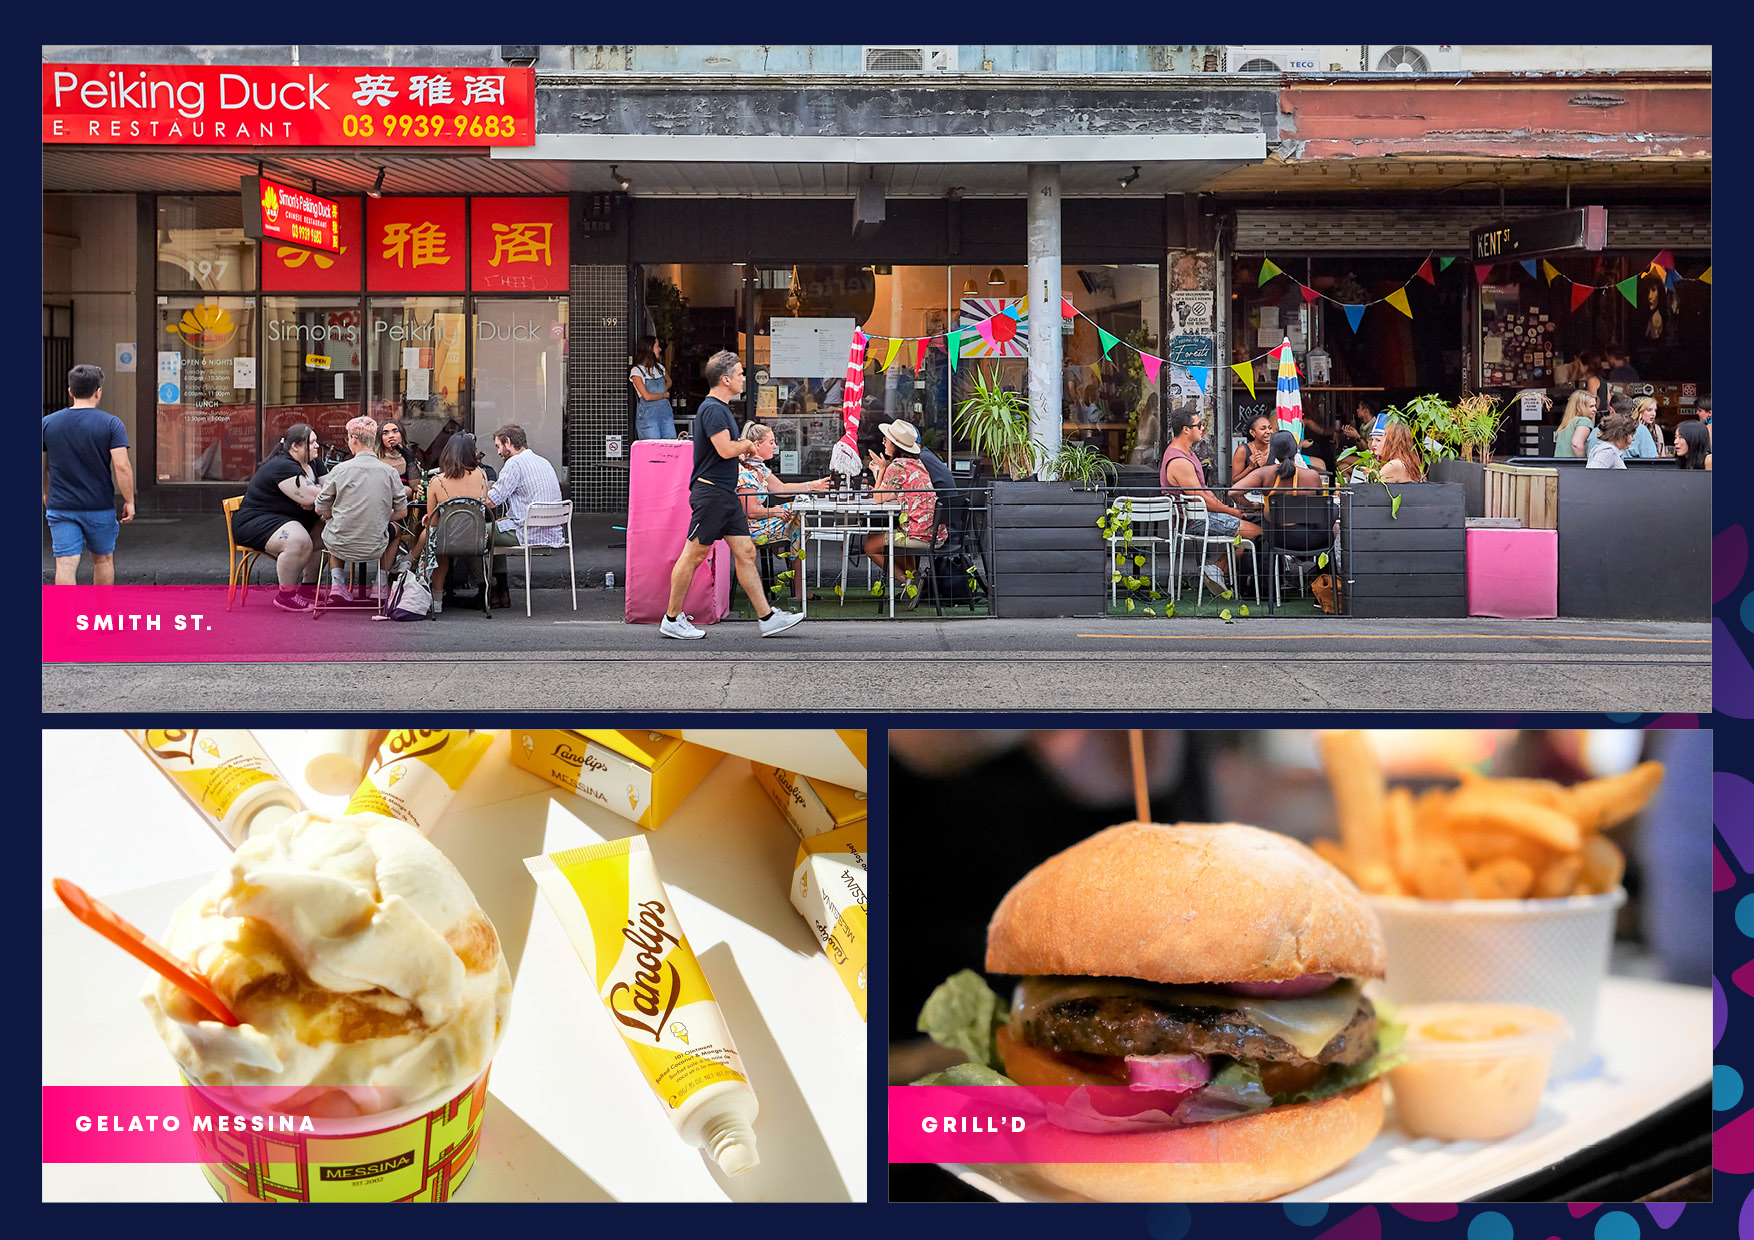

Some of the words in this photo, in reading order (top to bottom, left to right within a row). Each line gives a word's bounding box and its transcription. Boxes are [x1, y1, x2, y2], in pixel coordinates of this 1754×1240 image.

[54, 71, 204, 118] Peiking
[220, 73, 332, 110] Duck
[352, 74, 506, 107] 英雅阁
[53, 120, 63, 136] E
[89, 120, 292, 138] RESTAURANT
[343, 114, 374, 137] 03
[383, 115, 444, 137] 9939
[454, 115, 515, 137] 9683
[279, 189, 299, 210] Simon's
[300, 194, 318, 218] Peiking
[318, 201, 332, 219] Duck
[292, 223, 299, 239] 03
[1477, 230, 1502, 258] KENT
[1503, 228, 1511, 242] ST
[187, 260, 229, 281] 197
[268, 319, 357, 342] Simon's
[375, 319, 459, 346] Peiking
[478, 320, 541, 342] Duck
[602, 318, 618, 326] 199
[201, 358, 207, 366] 6
[310, 357, 327, 365] OPEN
[551, 743, 608, 772] Lanolips
[551, 769, 608, 803] MESSINA
[773, 767, 806, 808] Lanolips
[846, 843, 864, 864] Sorbet
[821, 888, 855, 943] MESSINA
[815, 919, 849, 965] Lanolips
[610, 900, 683, 1042] Lanolips
[684, 1044, 713, 1056] Ointment
[655, 1068, 671, 1084] Salted
[670, 1055, 694, 1070] Coconut
[701, 1048, 722, 1056] Mango
[326, 1156, 410, 1178] MESSINA
[365, 1177, 384, 1186] 2002
